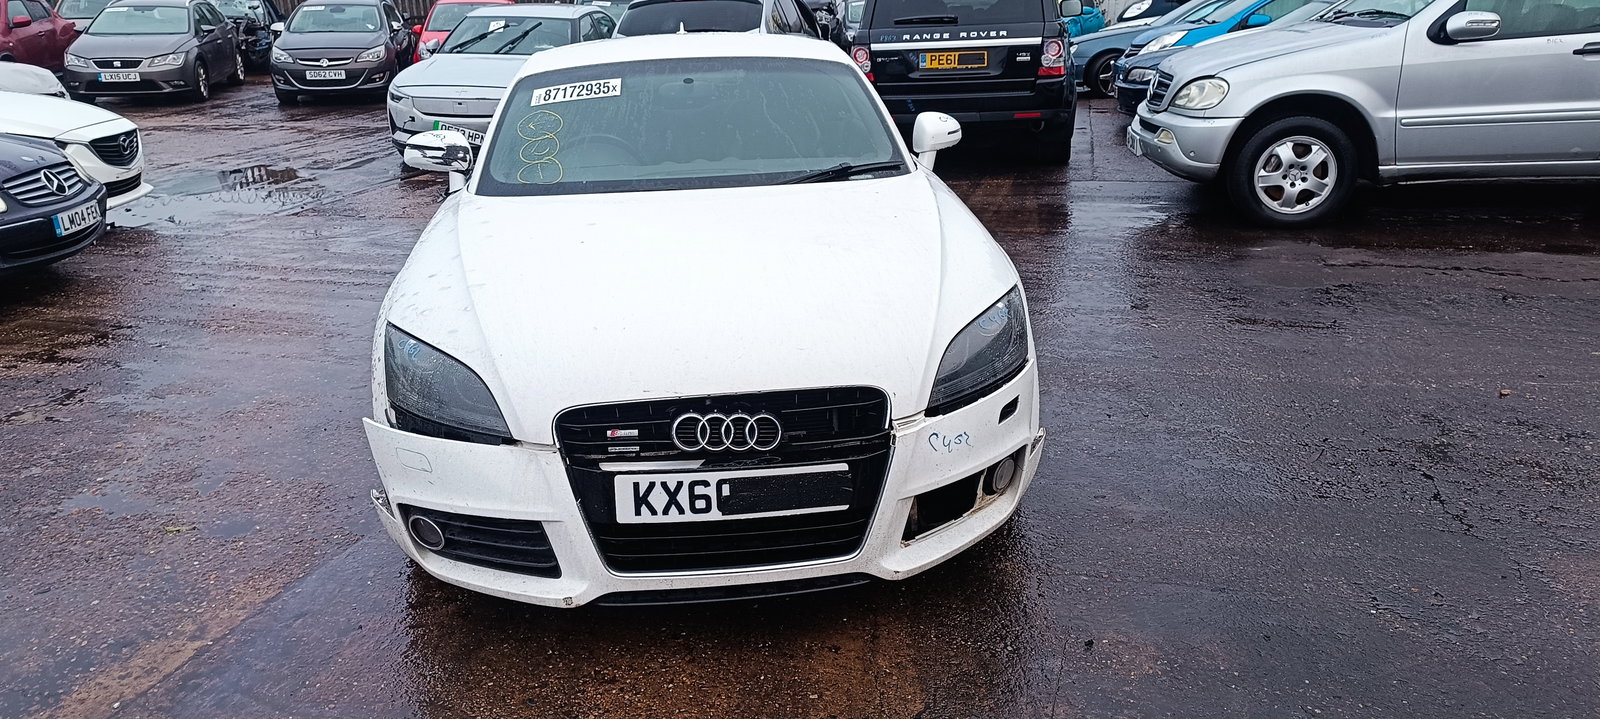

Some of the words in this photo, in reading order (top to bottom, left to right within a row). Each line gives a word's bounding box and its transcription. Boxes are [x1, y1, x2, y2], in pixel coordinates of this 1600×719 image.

[902, 32, 950, 41] RANGE
[959, 30, 1008, 38] ROVER
[930, 53, 957, 66] PE61
